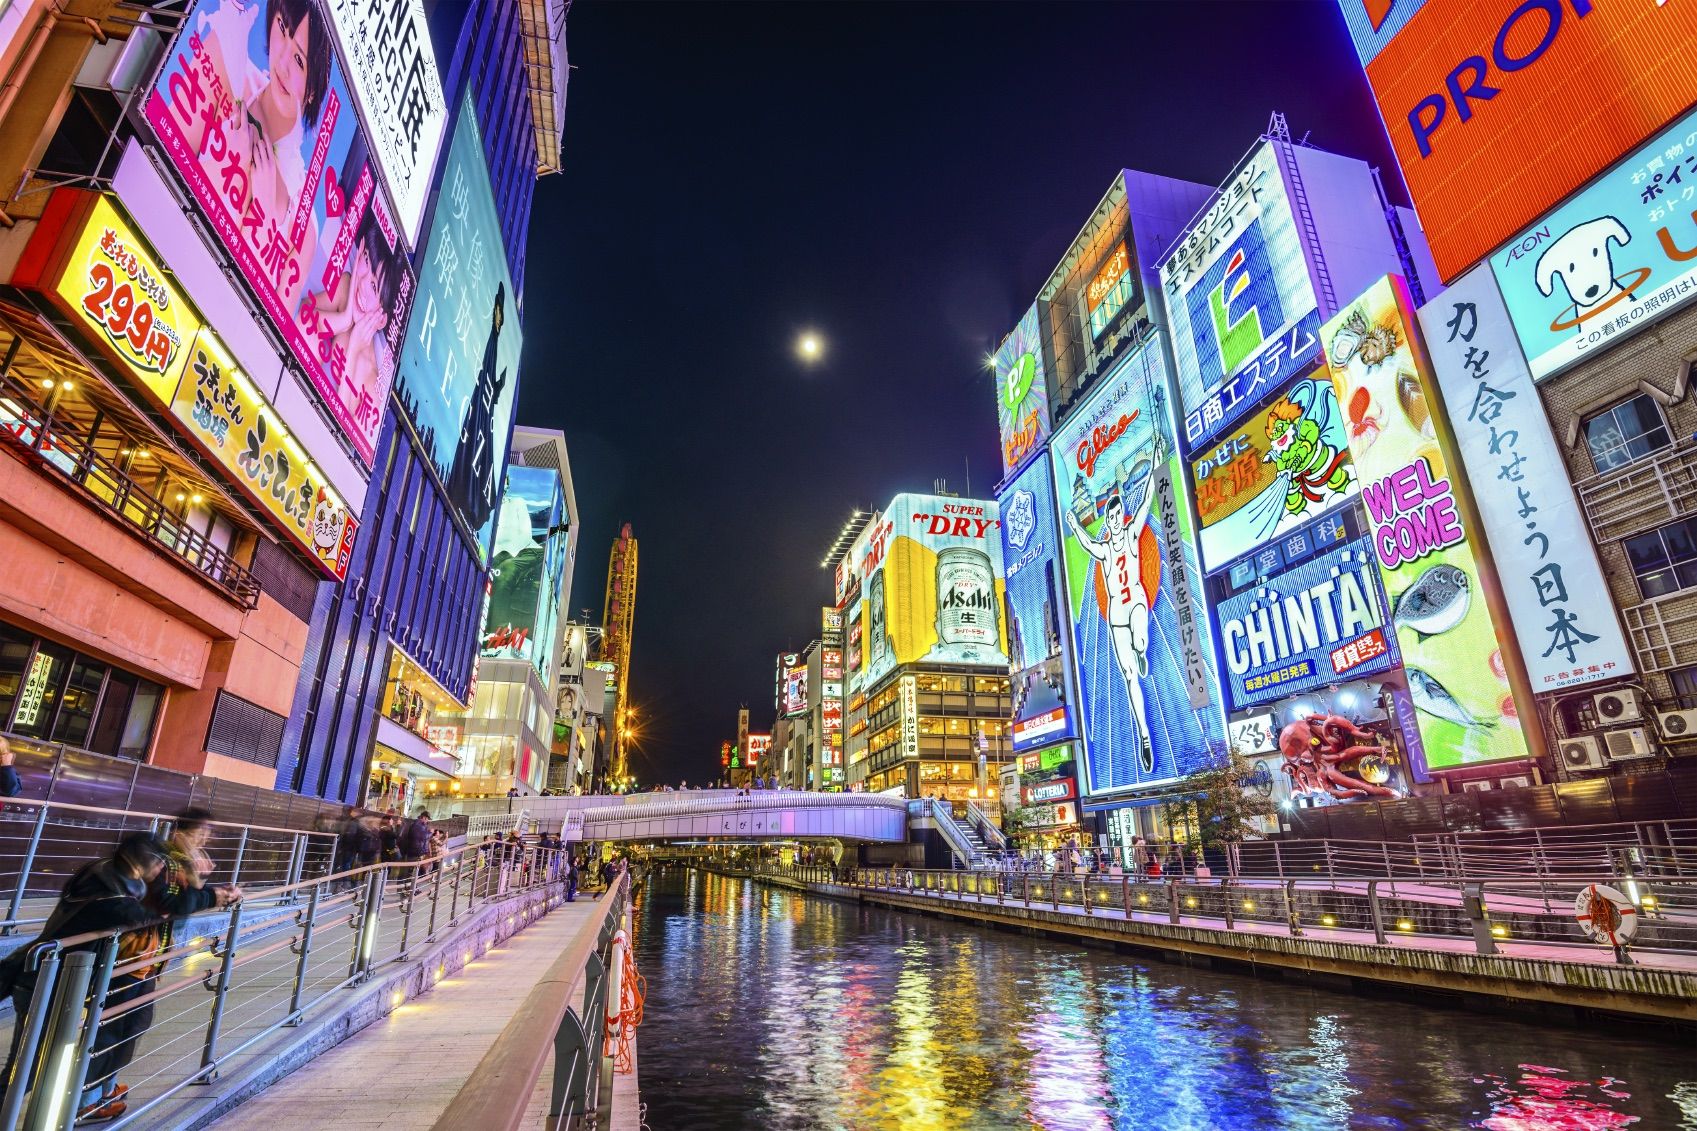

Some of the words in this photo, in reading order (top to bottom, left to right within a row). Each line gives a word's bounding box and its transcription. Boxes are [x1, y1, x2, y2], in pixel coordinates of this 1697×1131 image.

[1407, 0, 1593, 160] PRO
[1185, 327, 1316, 442] 日商エステム
[1076, 408, 1140, 479] Glico
[1195, 434, 1250, 480] かぜに
[942, 503, 984, 517] SUPER
[1362, 459, 1450, 524] WEL
[1445, 302, 1600, 664] 力を合わせよう日本
[1376, 496, 1462, 568] COME
[943, 585, 992, 611] Asahi
[1115, 550, 1132, 605] グリコ
[1158, 477, 1204, 694] みんなに笑顔を届けたい。
[960, 612, 976, 624] 生
[1226, 555, 1381, 677] CHINTAI
[1543, 661, 1616, 684] 広告募集中
[1384, 692, 1395, 719] 2F
[1034, 784, 1066, 798] LOTTERIA
